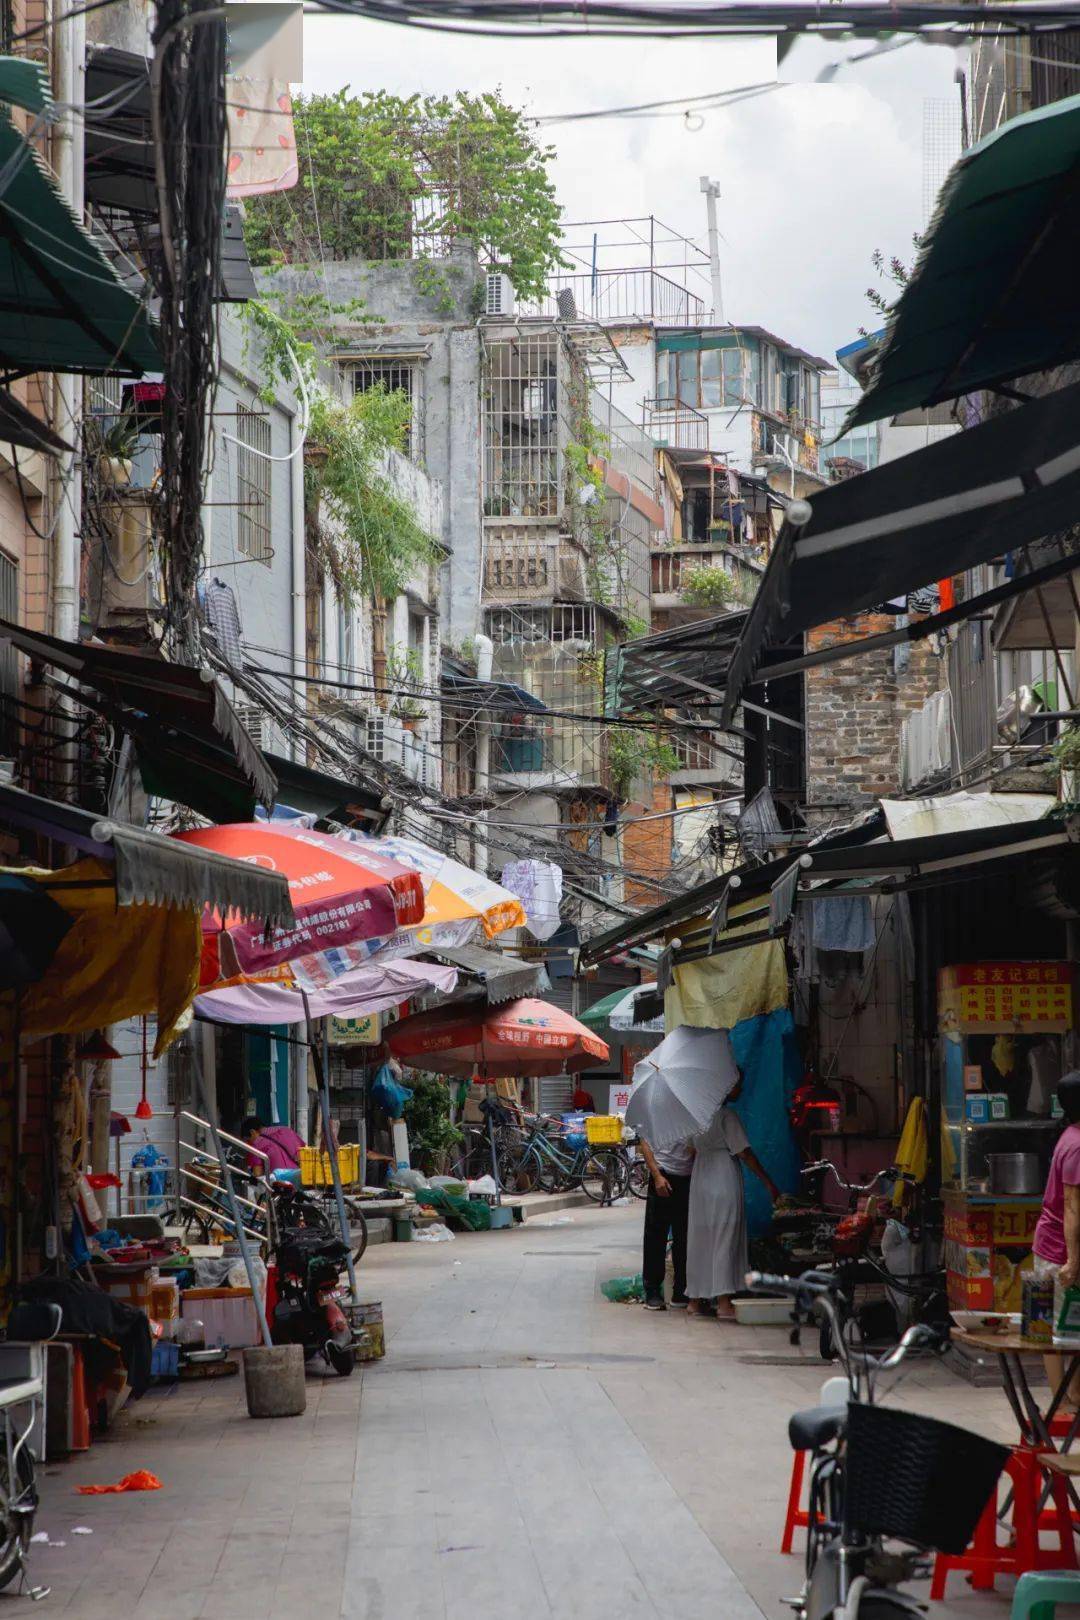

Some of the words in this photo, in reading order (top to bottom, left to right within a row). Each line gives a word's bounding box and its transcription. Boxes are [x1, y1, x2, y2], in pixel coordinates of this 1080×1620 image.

[272, 929, 312, 952] 证券代码
[316, 919, 351, 936] 002181
